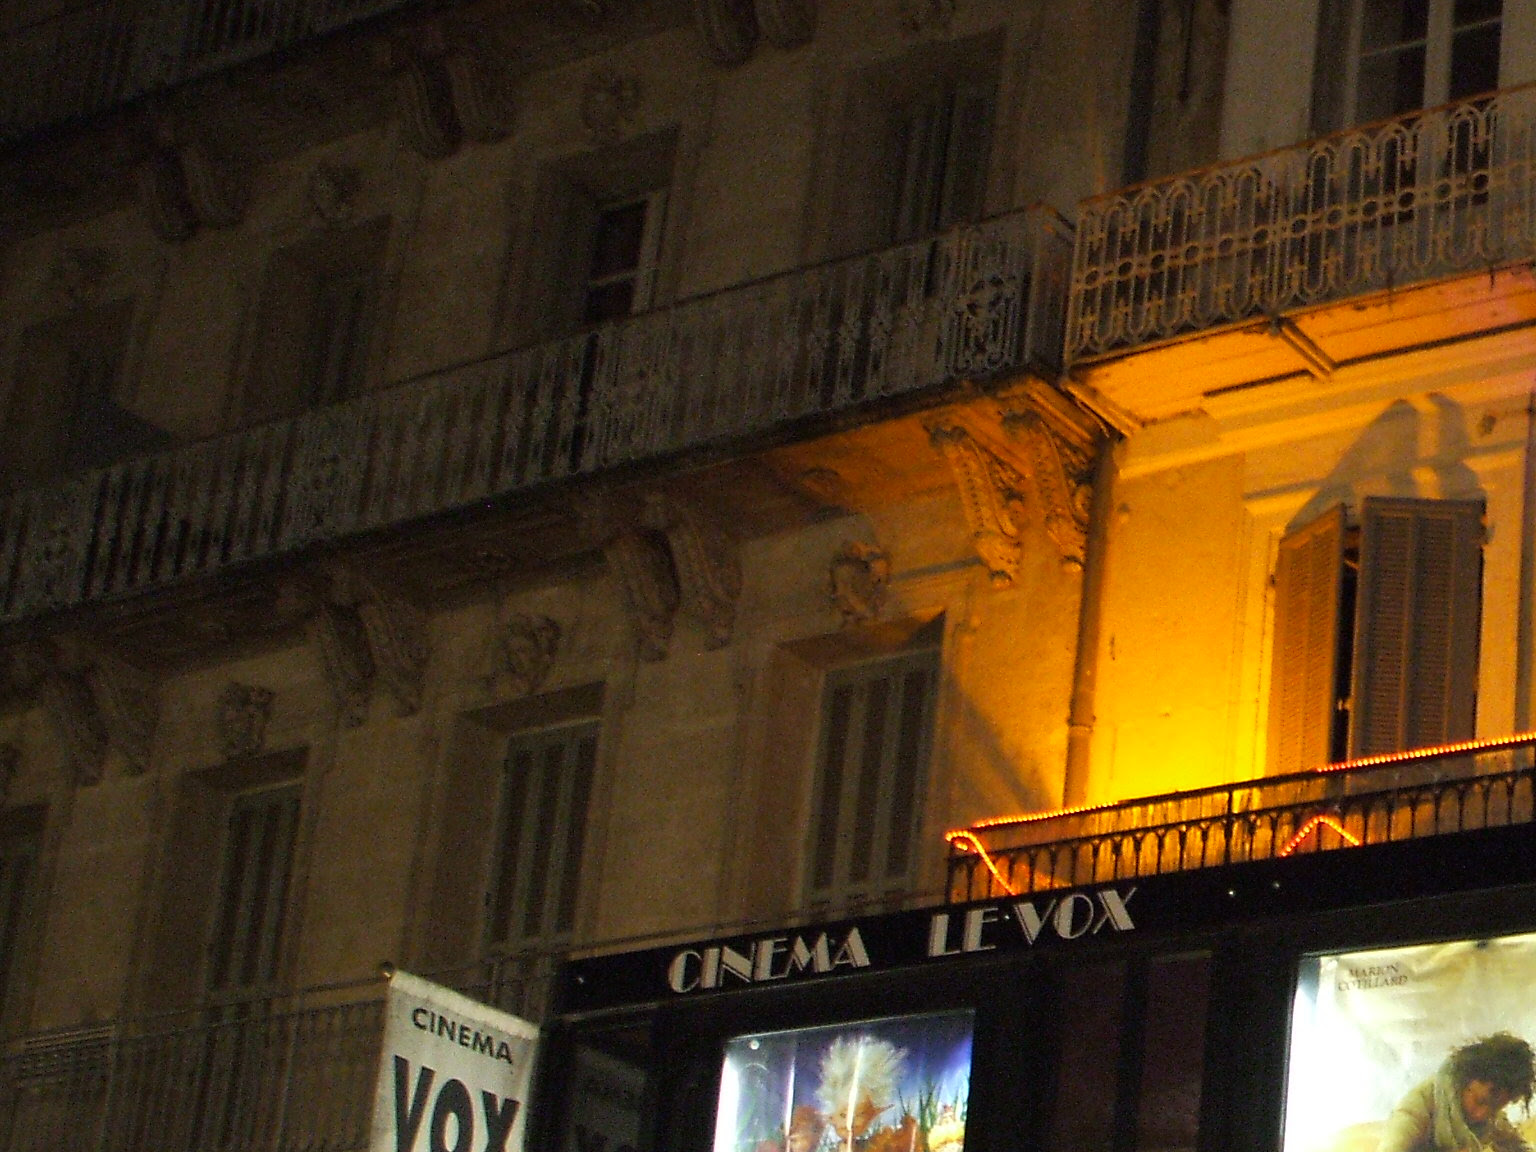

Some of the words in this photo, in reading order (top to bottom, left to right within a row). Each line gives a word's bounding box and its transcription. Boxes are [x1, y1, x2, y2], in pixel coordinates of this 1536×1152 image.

[668, 926, 870, 993] CINEMA
[928, 907, 999, 957] LE
[1013, 887, 1137, 945] VOX
[412, 1008, 513, 1064] CINEMA
